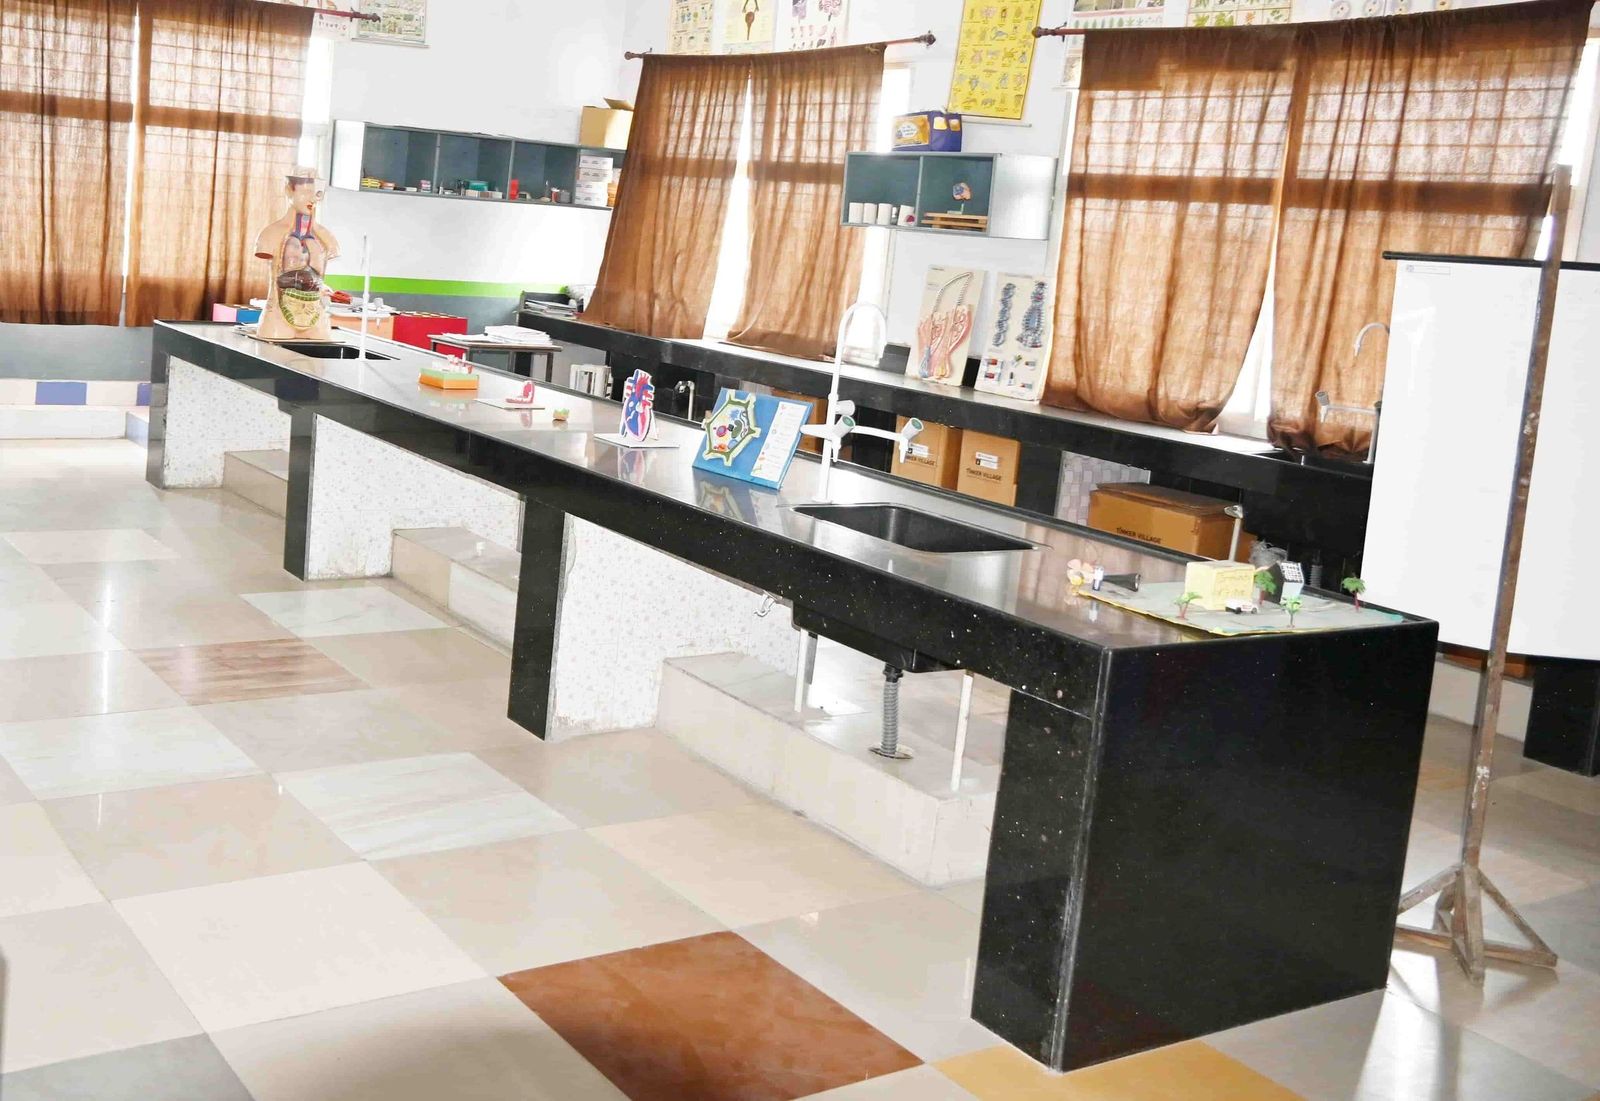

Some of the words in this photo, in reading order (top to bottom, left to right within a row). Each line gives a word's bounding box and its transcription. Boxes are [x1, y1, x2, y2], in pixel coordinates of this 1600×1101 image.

[982, 472, 1002, 481] VILLAGE
[1116, 527, 1136, 537] TINKER
[1138, 534, 1161, 544] VILLAGE
